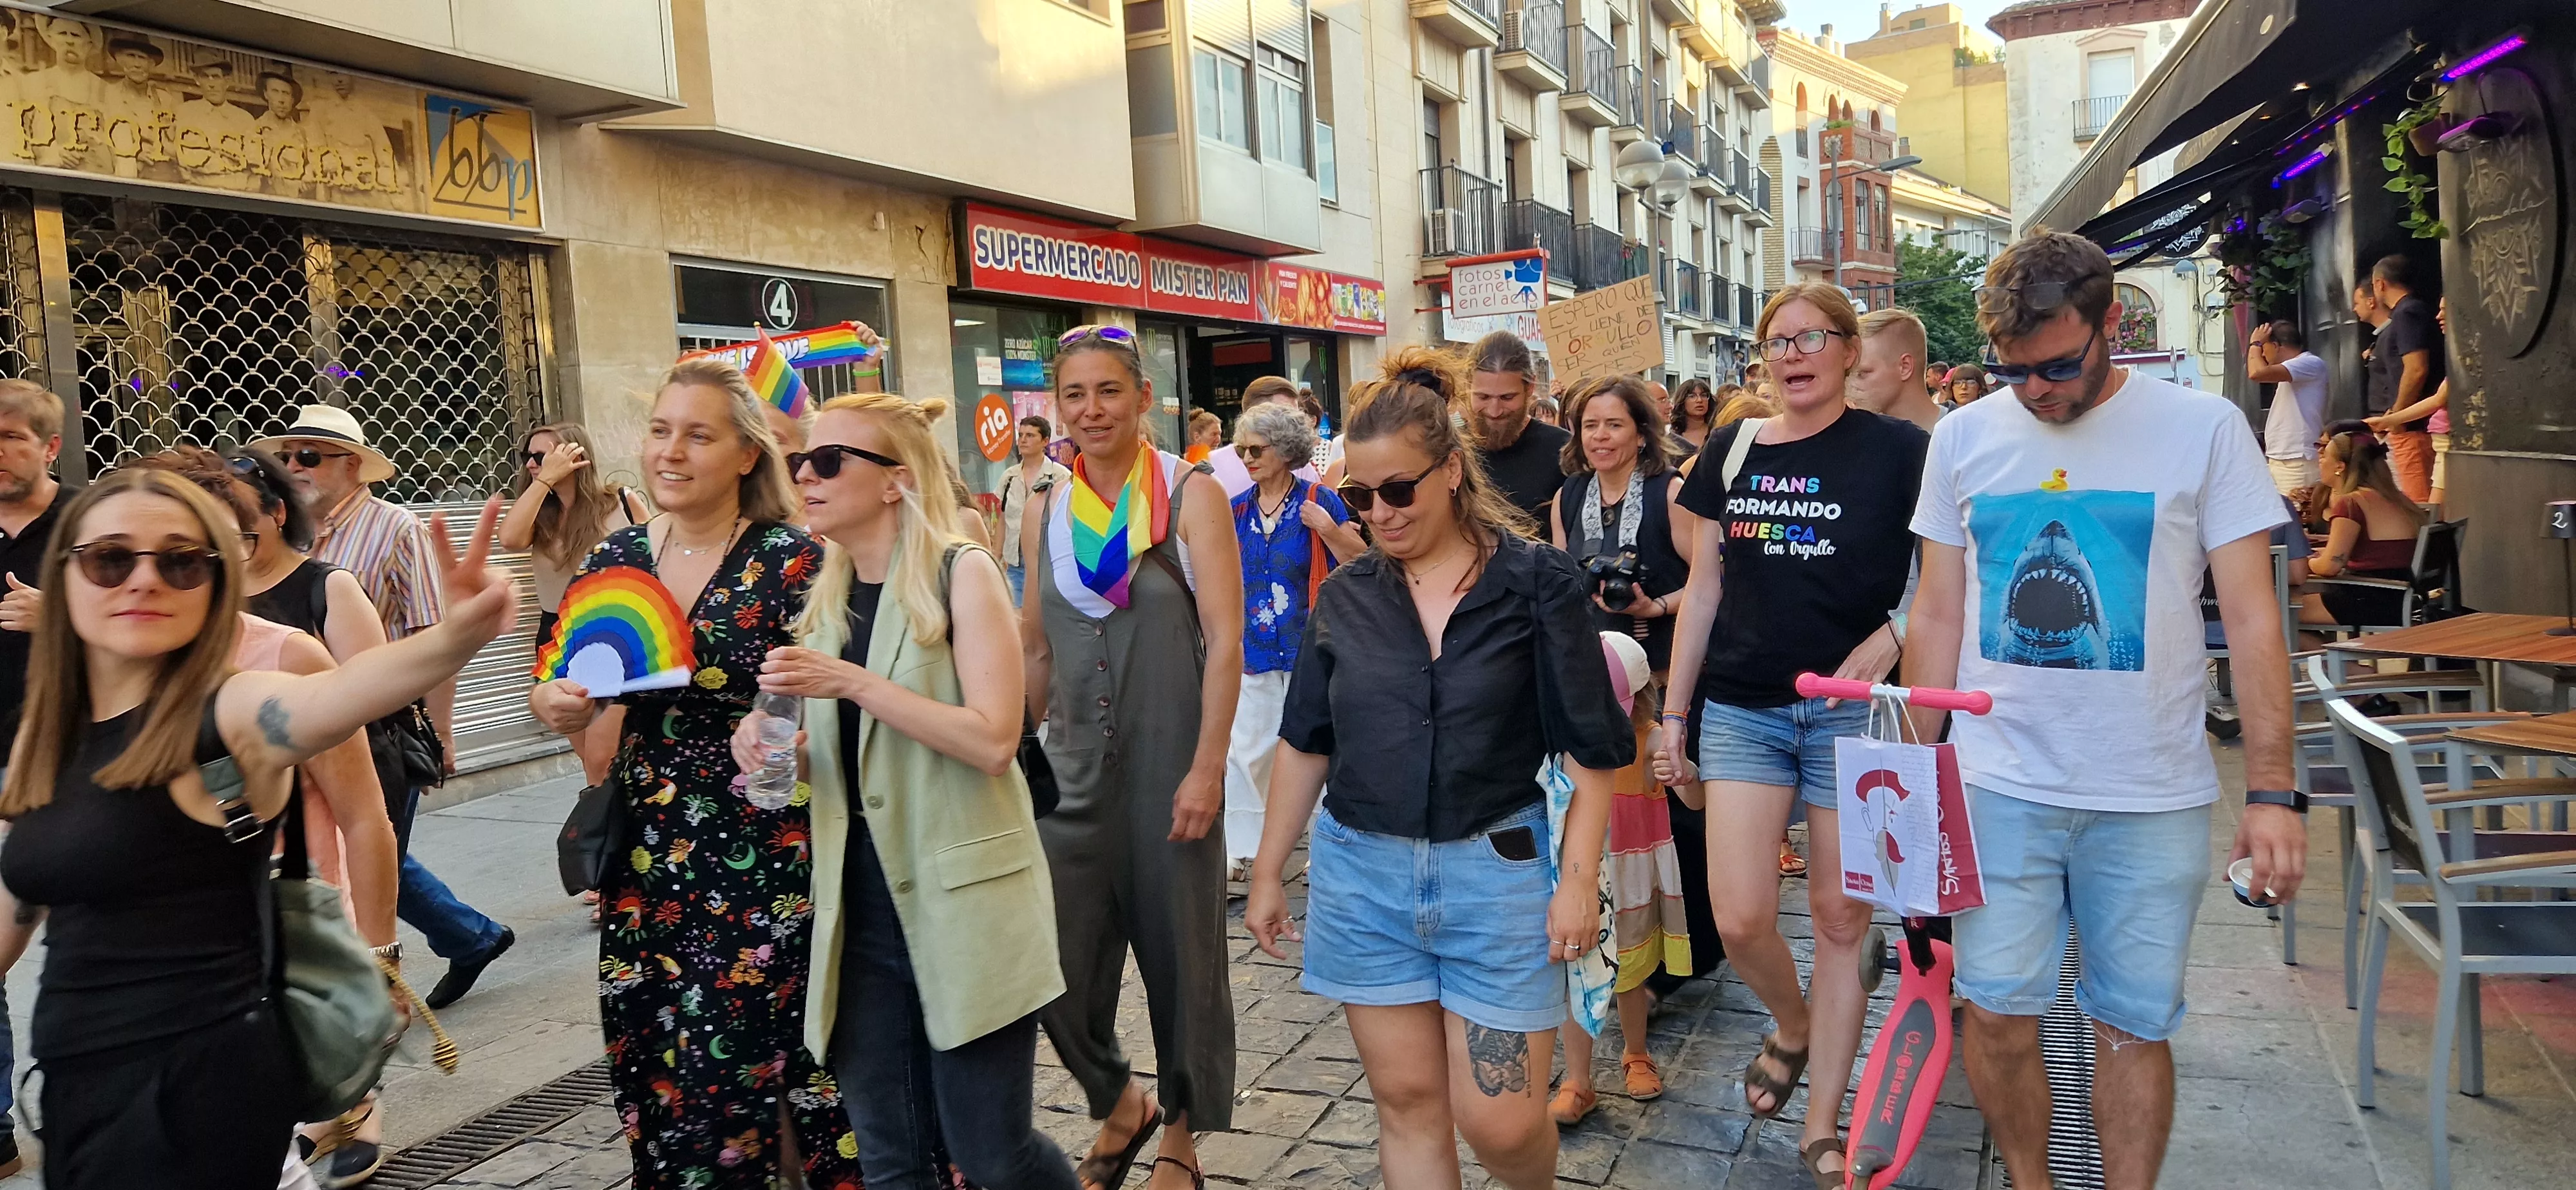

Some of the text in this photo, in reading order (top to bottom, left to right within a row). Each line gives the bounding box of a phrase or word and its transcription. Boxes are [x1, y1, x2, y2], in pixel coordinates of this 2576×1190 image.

[6, 103, 402, 195] profesional
[973, 224, 1249, 305] SUPERMERCADO MISTER PAN
[1458, 269, 1501, 283] fotos
[1459, 279, 1511, 296] carnet
[770, 283, 791, 325] 4
[1459, 292, 1537, 309] en el acto
[1548, 278, 1654, 329] ESPERO QUE
[1517, 315, 1546, 342] GUAR
[1547, 326, 1580, 343] TE
[1636, 304, 1655, 318] DE
[1005, 337, 1016, 348] ZERO
[1568, 319, 1653, 354] ORGULLO
[775, 337, 810, 361] OVE
[1005, 349, 1036, 361] 100% MONSTER
[1557, 353, 1592, 377] SER
[1580, 351, 1645, 377] ERES
[981, 406, 1009, 446] ria
[1750, 475, 1820, 494] TRANS
[1726, 497, 1842, 520] FORMANDO
[2552, 511, 2569, 529] 2
[1730, 521, 1815, 543] HUESCA
[1764, 538, 1837, 560] Con Orgullo
[1880, 1031, 1922, 1126] GLOBBER
